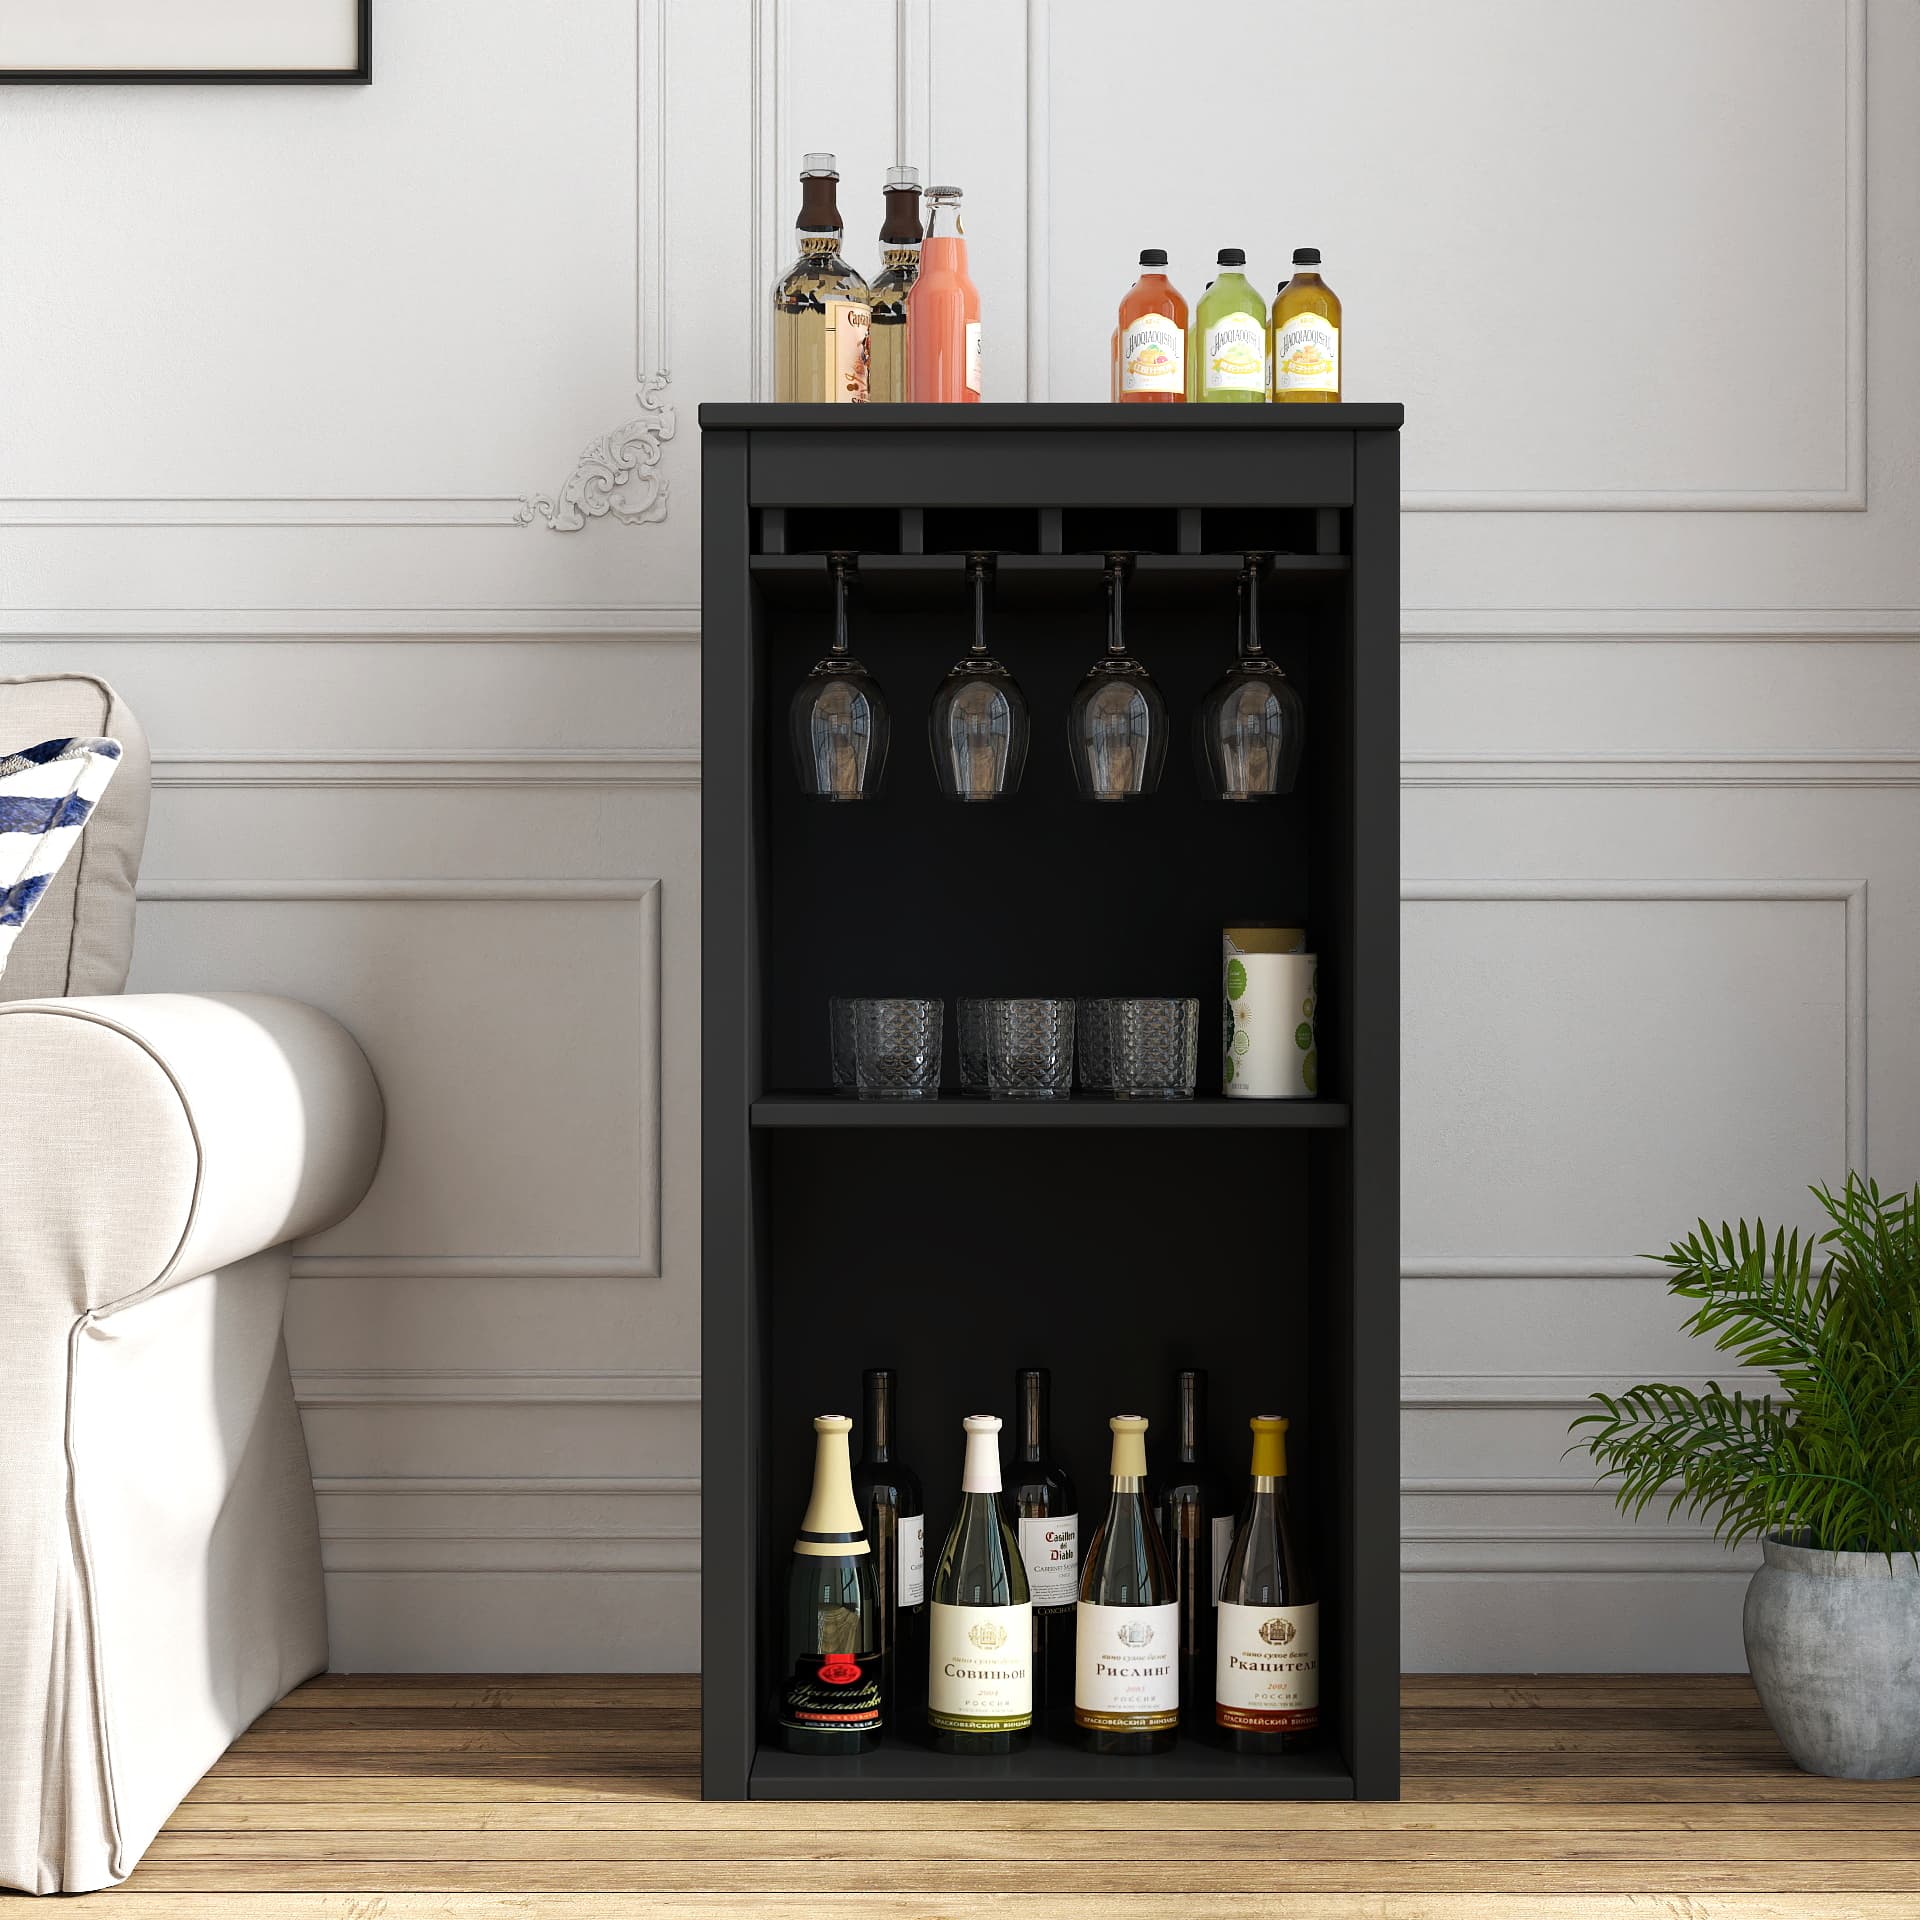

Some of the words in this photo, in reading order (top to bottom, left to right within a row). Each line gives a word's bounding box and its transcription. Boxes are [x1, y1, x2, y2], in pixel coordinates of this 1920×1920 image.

[944, 1663, 1026, 1680] Совиньон
[1096, 1663, 1171, 1677] Рислинг
[1254, 1693, 1298, 1701] РОССИЯ
